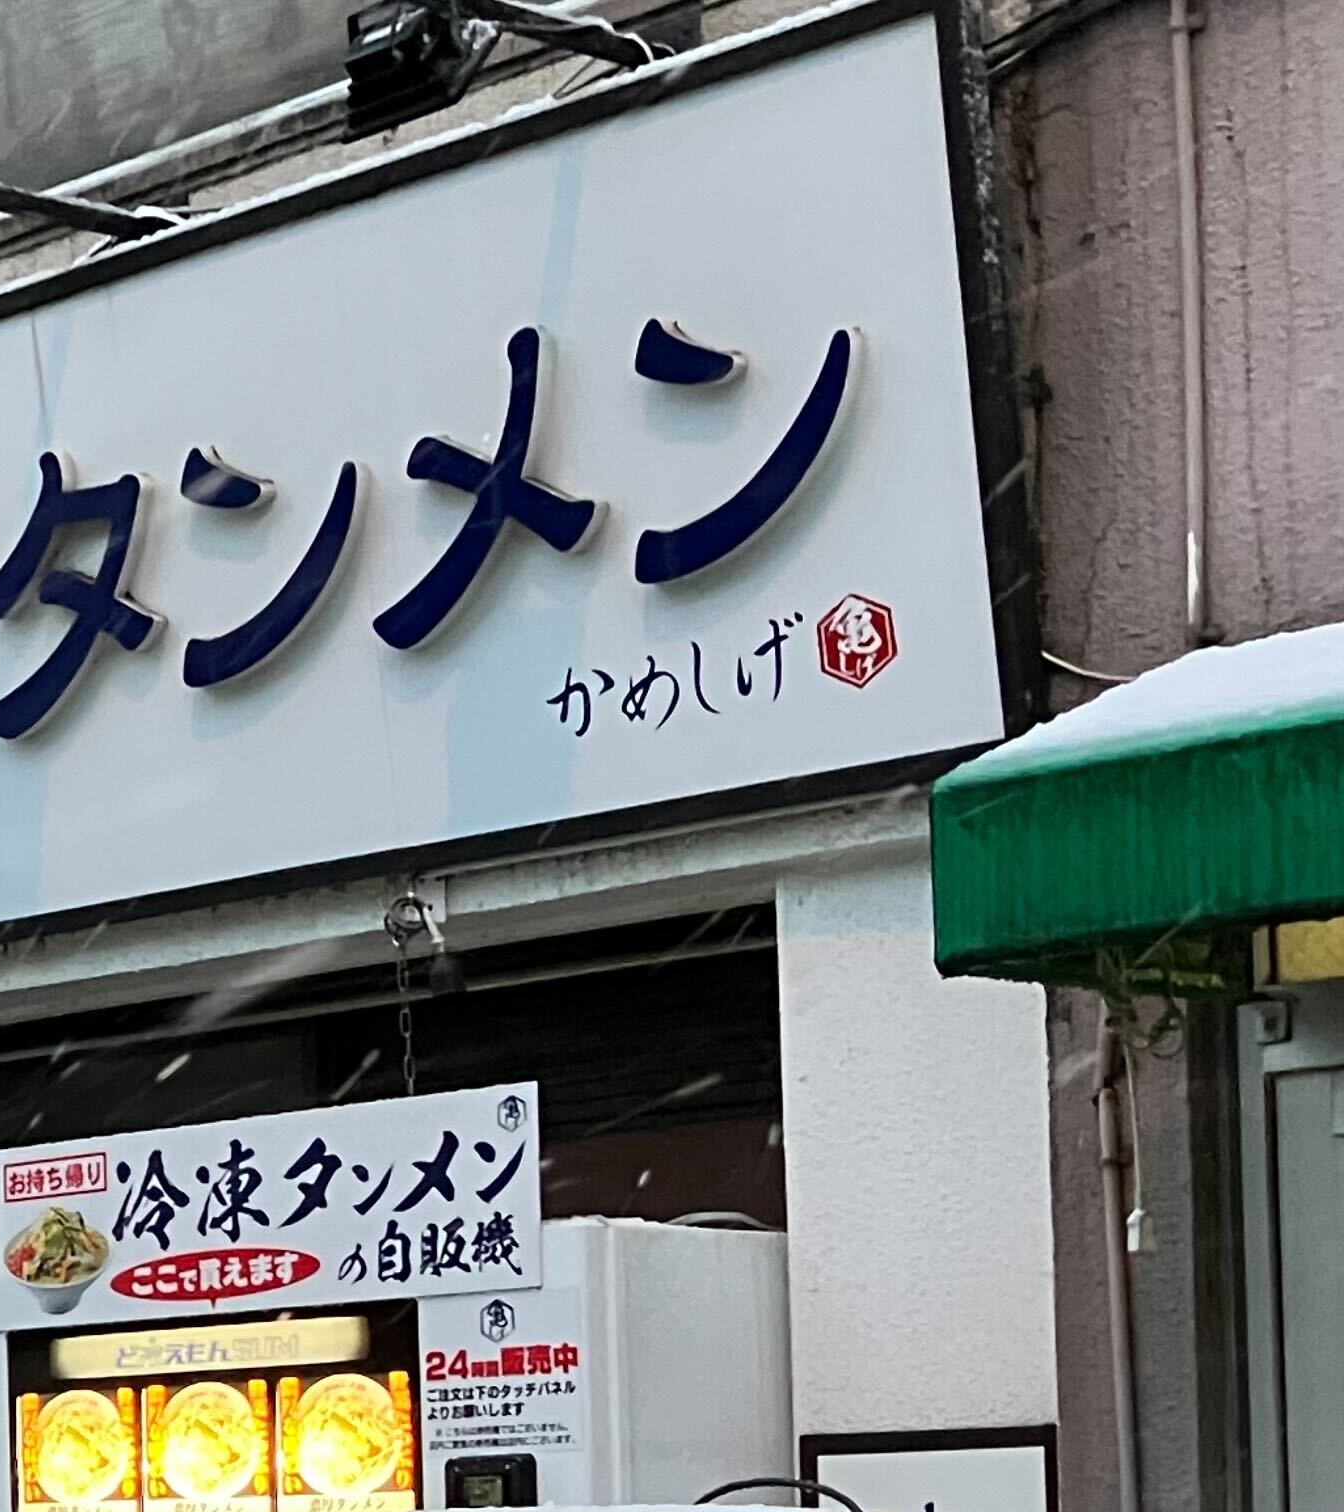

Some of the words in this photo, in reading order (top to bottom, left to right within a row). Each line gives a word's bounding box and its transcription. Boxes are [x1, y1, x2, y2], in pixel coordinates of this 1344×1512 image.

[546, 611, 804, 740] かめしげ
[8, 1161, 102, 1196] お持ち帰り
[112, 1129, 528, 1251] 冷凍タンメン
[131, 1252, 299, 1297] ここで買えます
[337, 1212, 523, 1285] の自販機
